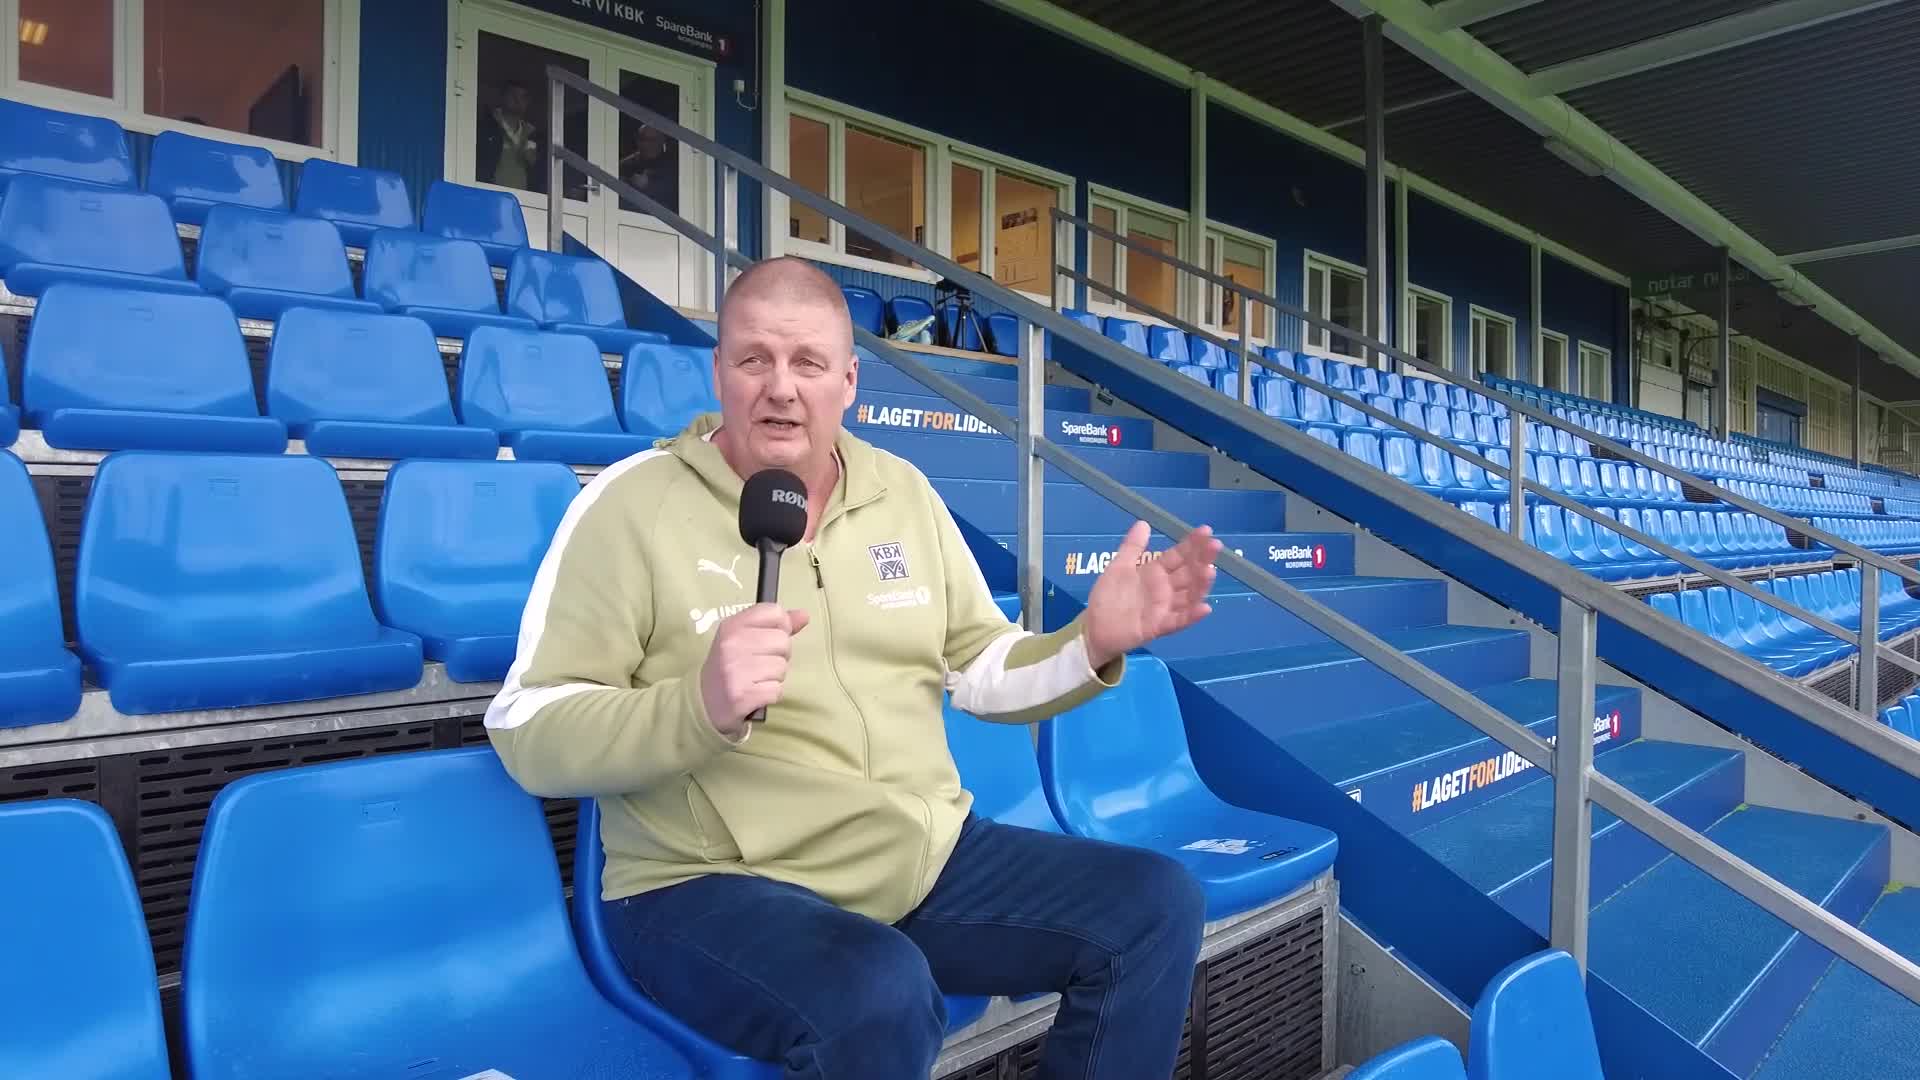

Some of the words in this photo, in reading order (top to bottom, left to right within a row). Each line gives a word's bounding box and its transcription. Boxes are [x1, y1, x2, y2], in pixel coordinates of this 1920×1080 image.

[614, 2, 645, 25] KBK
[656, 16, 713, 43] SpareBank
[857, 404, 1003, 434] #LAGETFORLIDE
[1061, 420, 1107, 437] SpareBank
[1268, 545, 1312, 562] SpareBank
[1411, 751, 1535, 813] #LAGETFORLIDEN
